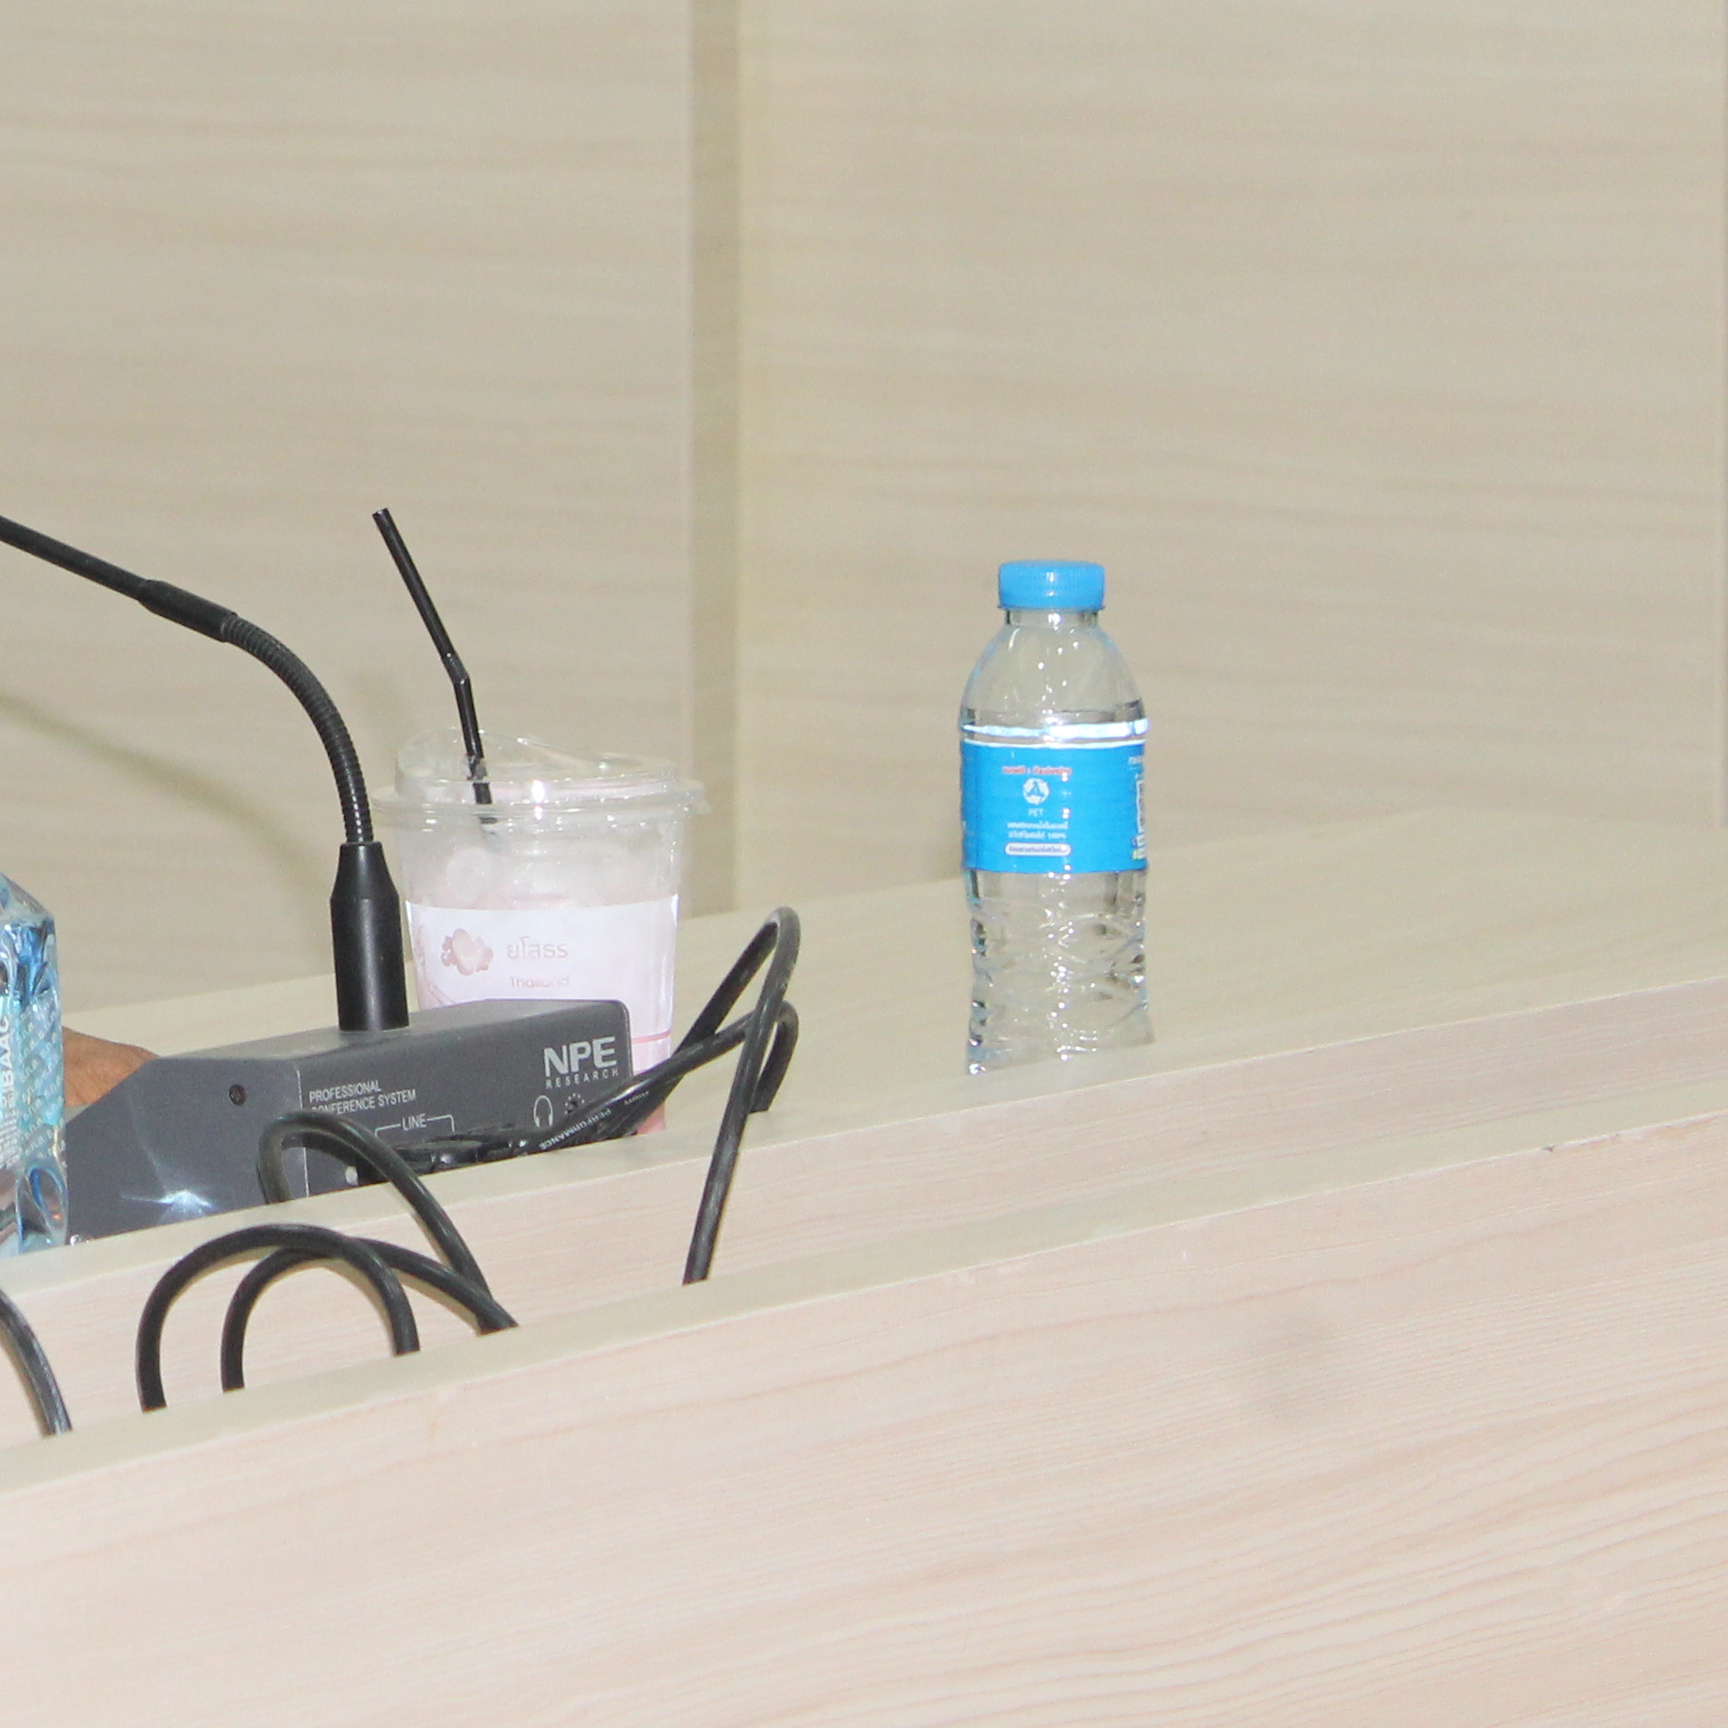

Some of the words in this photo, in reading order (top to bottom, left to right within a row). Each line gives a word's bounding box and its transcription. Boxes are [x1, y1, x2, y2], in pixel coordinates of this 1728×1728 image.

[507, 935, 569, 959] ยโสธร
[544, 1036, 617, 1077] NPE
[546, 1068, 619, 1089] RESEARCH
[309, 1080, 382, 1103] PROFESSIONAL
[378, 1089, 417, 1107] SYSTEM
[402, 1113, 428, 1131] LINE
